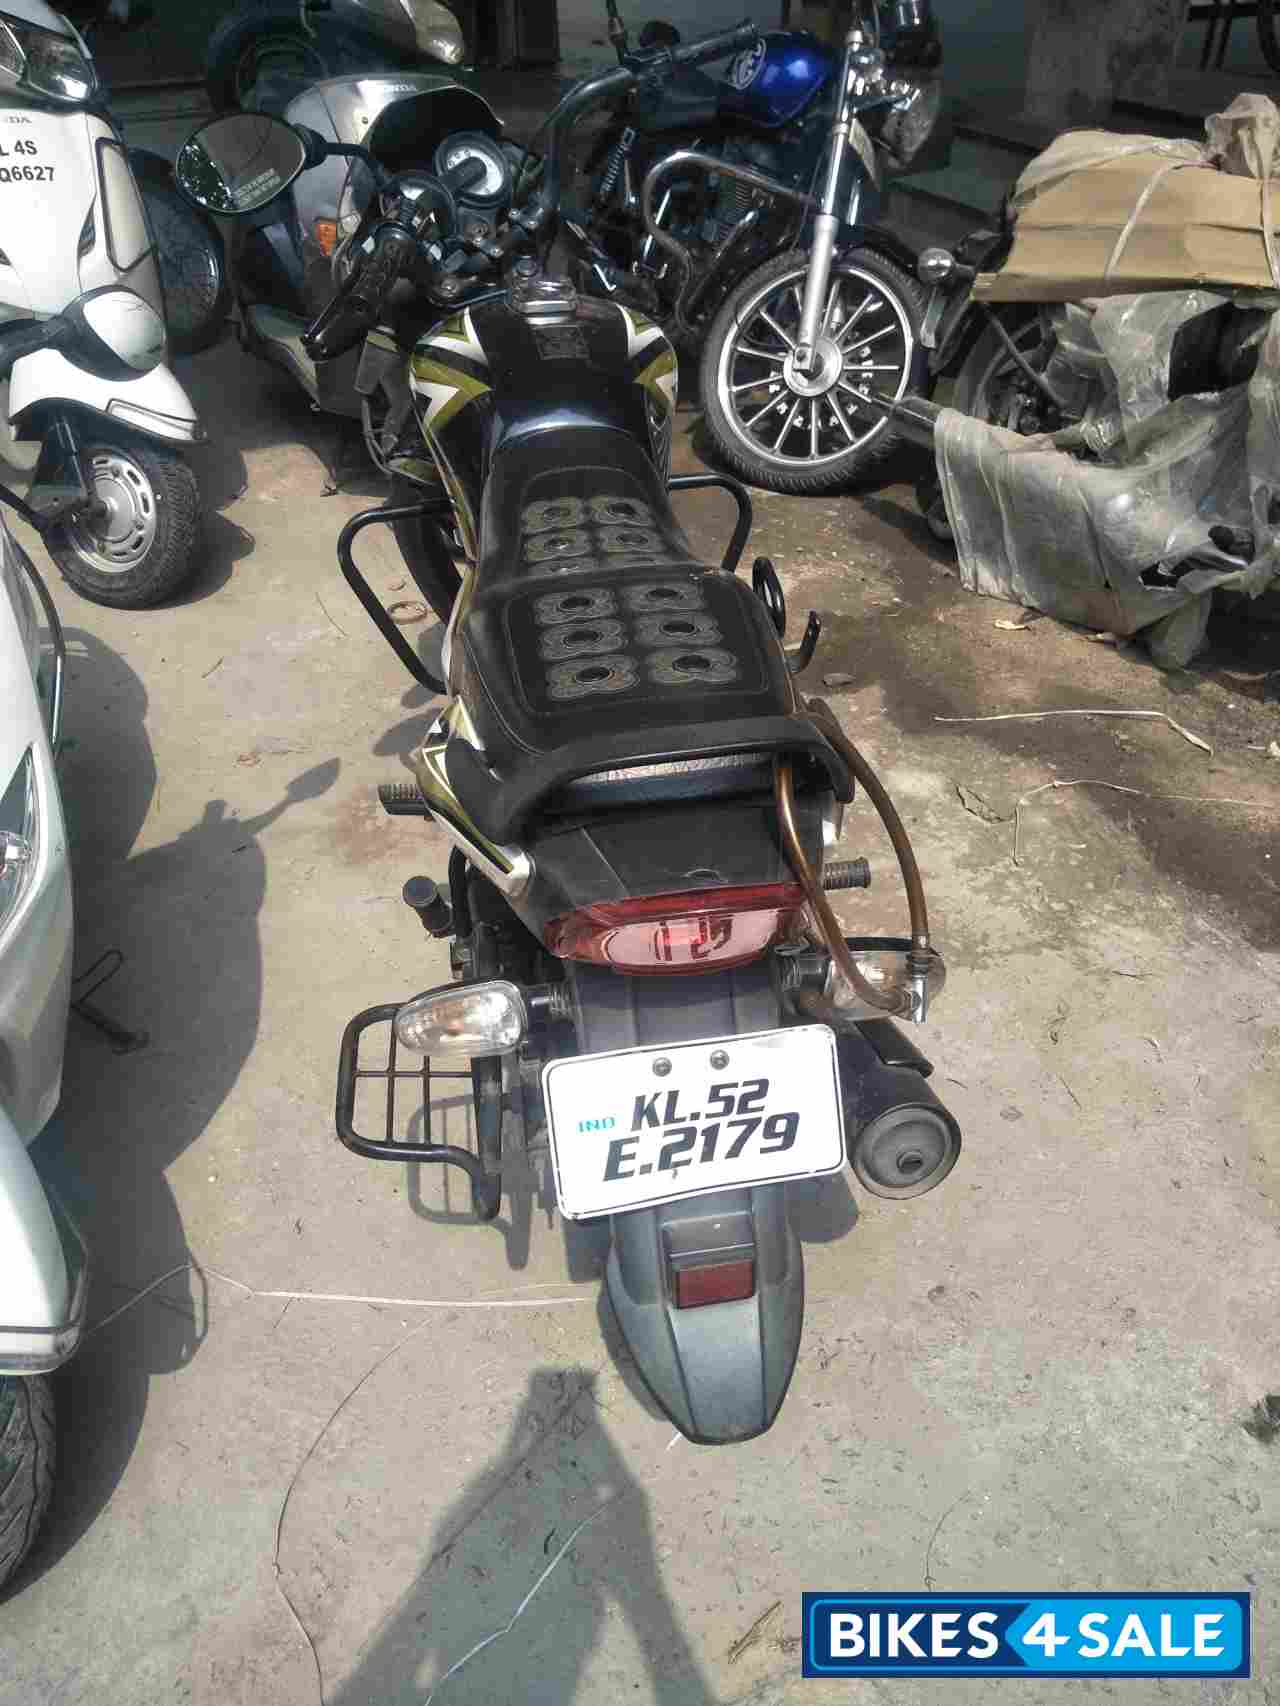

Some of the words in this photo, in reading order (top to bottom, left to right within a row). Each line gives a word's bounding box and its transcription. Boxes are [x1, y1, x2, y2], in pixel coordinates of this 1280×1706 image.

[14, 140, 38, 155] 4S
[0, 165, 54, 182] Q6627
[631, 1078, 769, 1132] KL.52
[578, 1116, 616, 1134] IND
[603, 1112, 800, 1182] E.2179
